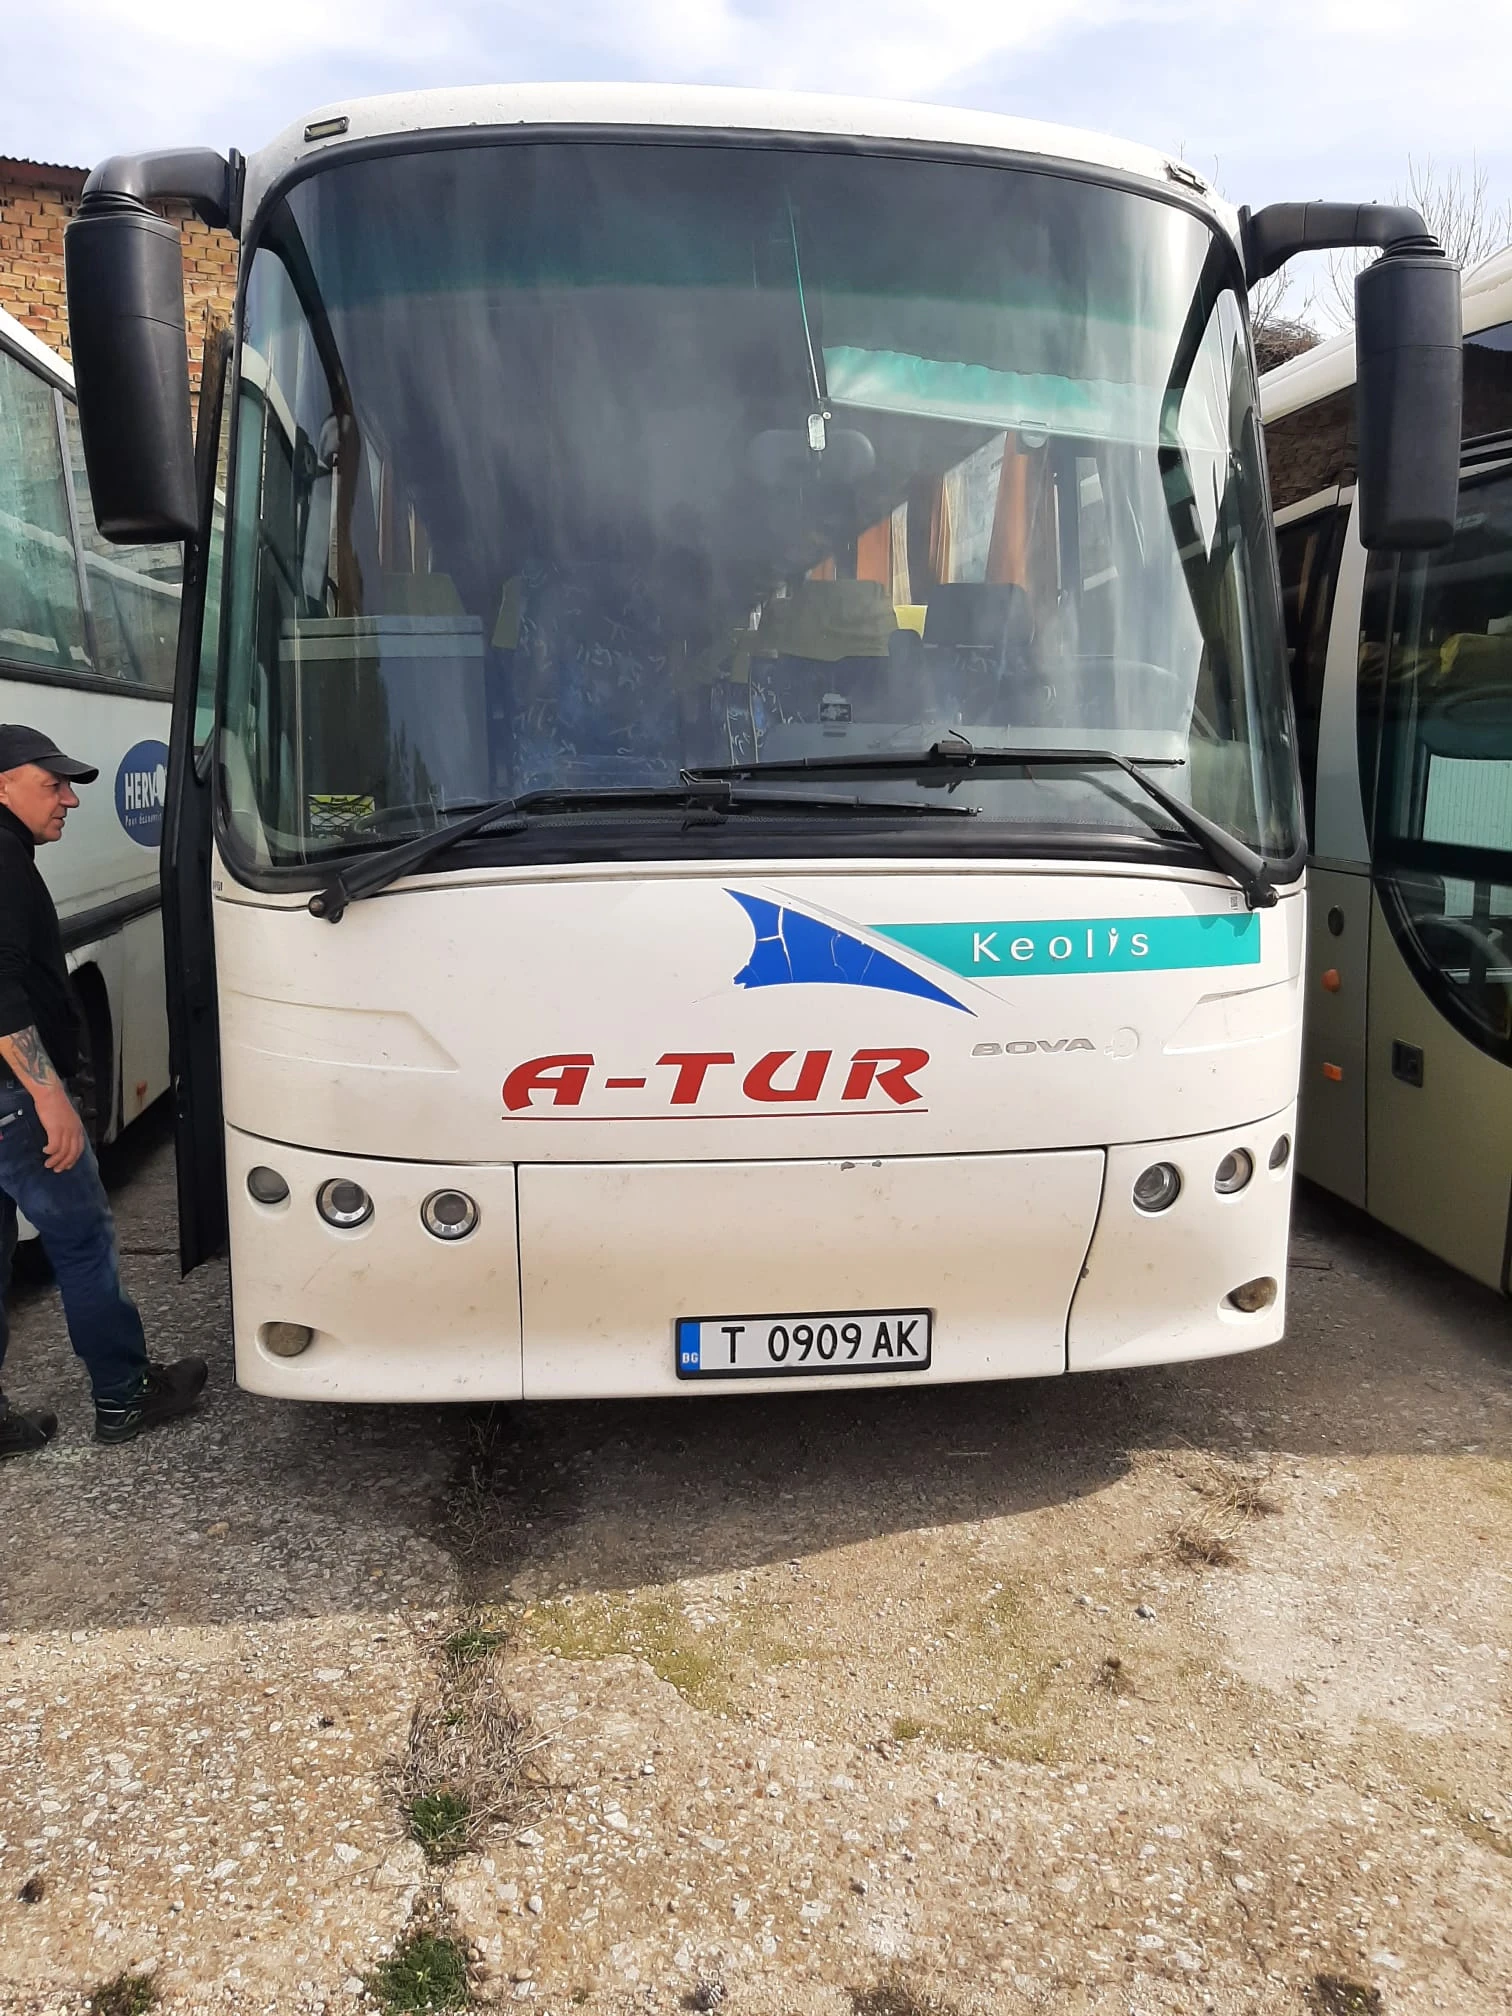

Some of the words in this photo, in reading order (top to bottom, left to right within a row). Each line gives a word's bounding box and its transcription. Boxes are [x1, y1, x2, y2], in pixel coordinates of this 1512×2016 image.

[973, 927, 1150, 963] Keolis
[971, 1037, 1097, 1057] BOVA
[501, 1047, 931, 1111] A-TUR
[682, 1352, 699, 1364] BG
[721, 1326, 746, 1364] T
[767, 1322, 862, 1362] 0909
[871, 1319, 919, 1358] AK
